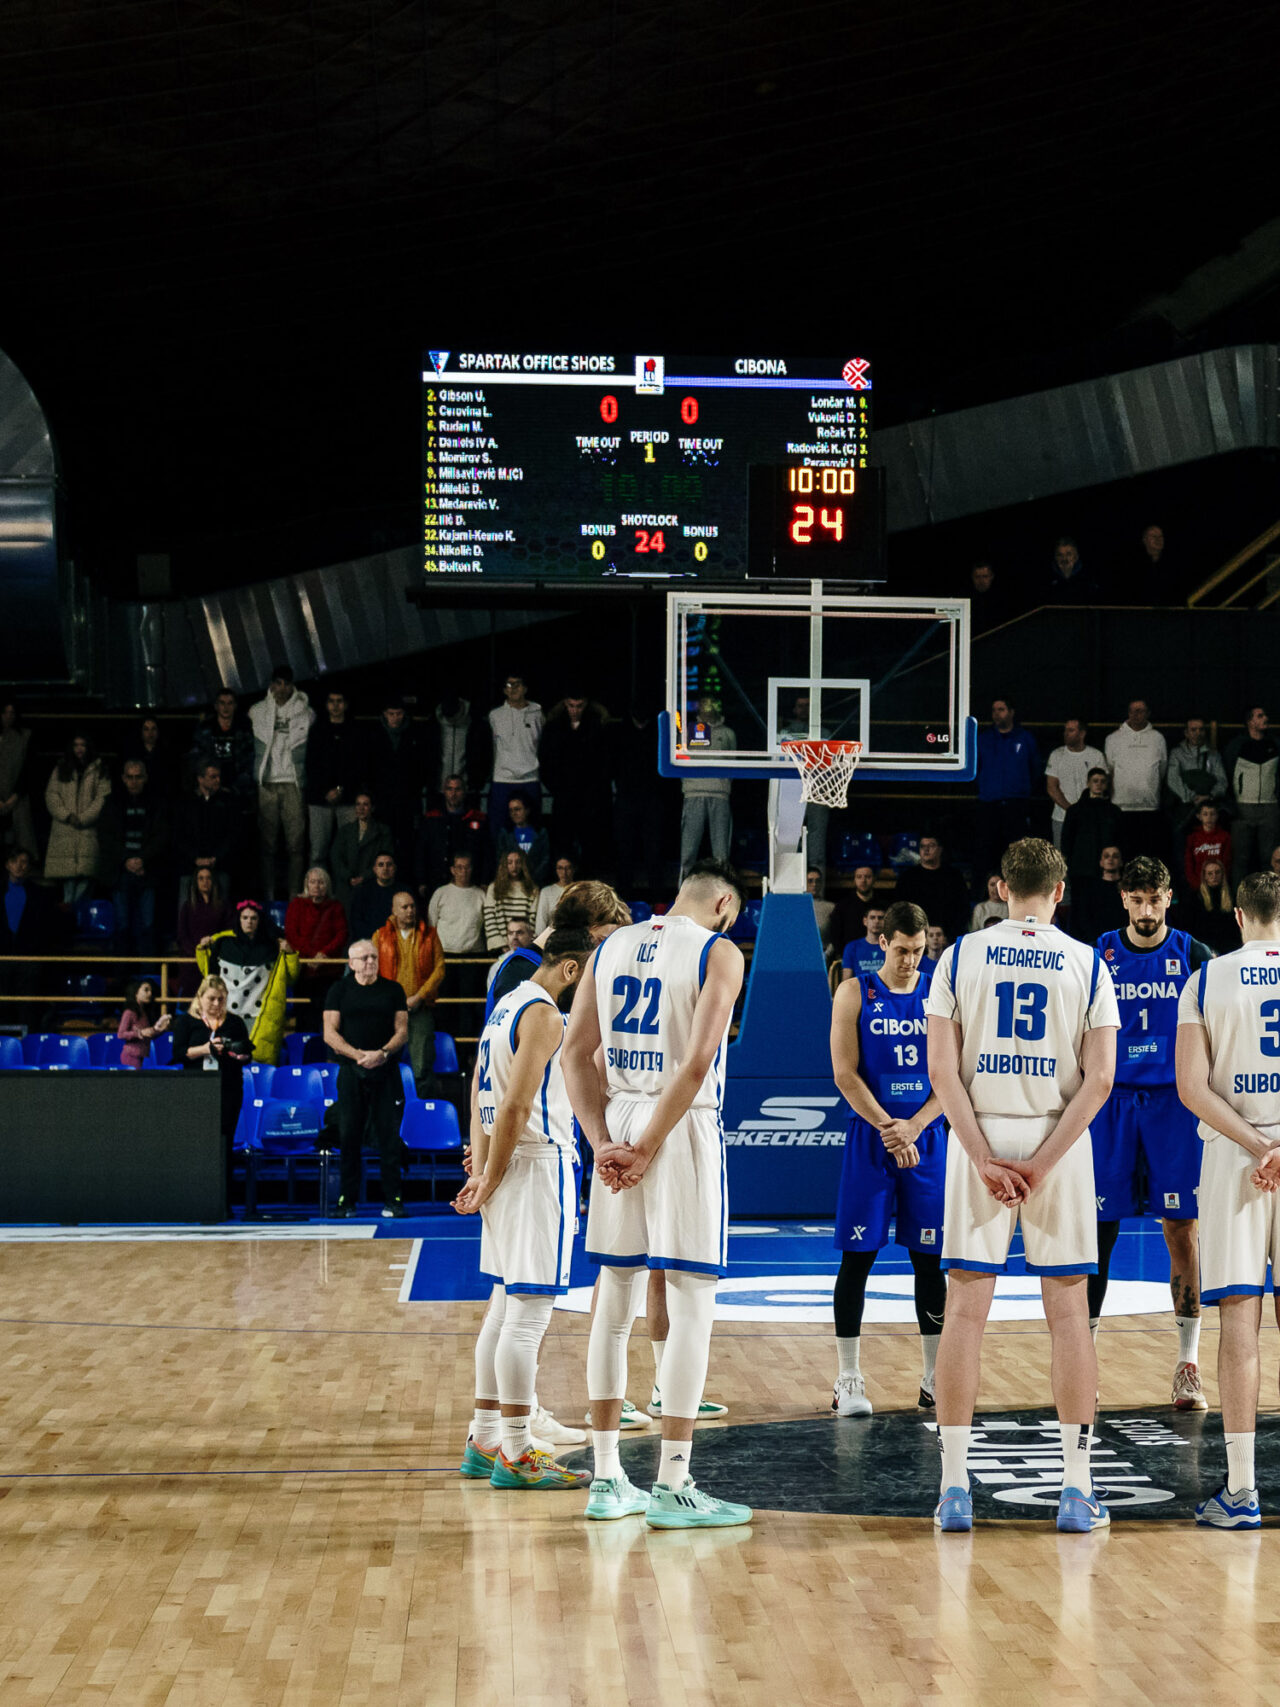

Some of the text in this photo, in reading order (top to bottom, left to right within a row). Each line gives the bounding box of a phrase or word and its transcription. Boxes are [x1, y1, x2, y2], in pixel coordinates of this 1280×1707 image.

[459, 353, 616, 372] SPARTAK OFFICE SHOES
[735, 359, 787, 375] CIBONA
[439, 389, 474, 402] Gibson
[600, 395, 618, 423] 0
[681, 396, 699, 424] 0
[576, 436, 621, 448] TIME OUT
[630, 431, 670, 443] PERIOD
[678, 438, 724, 450] TIME OUT
[482, 452, 493, 463] S.
[644, 442, 656, 463] 1
[790, 468, 855, 494] 10:00
[489, 499, 499, 510] V.
[621, 514, 678, 526] SHOTCLOCK
[792, 505, 843, 542] 24
[581, 525, 616, 536] BONUS
[683, 526, 718, 537] BONUS
[592, 540, 605, 560] 0
[634, 530, 666, 553] 24
[694, 541, 708, 561] 0
[937, 734, 949, 742] LG
[986, 945, 1065, 971] MEDAREVIĆ
[611, 975, 662, 1035] 22
[995, 981, 1048, 1041] 13
[869, 1018, 928, 1036] CIBON
[1138, 1008, 1148, 1030] 1
[893, 1044, 919, 1066] 13
[1128, 1045, 1149, 1053] ERSTE
[607, 1047, 664, 1072] SUBOTIA
[976, 1053, 1057, 1078] SUBOTICA
[890, 1082, 915, 1091] ERSTE
[1104, 1419, 1191, 1446] SHOES
